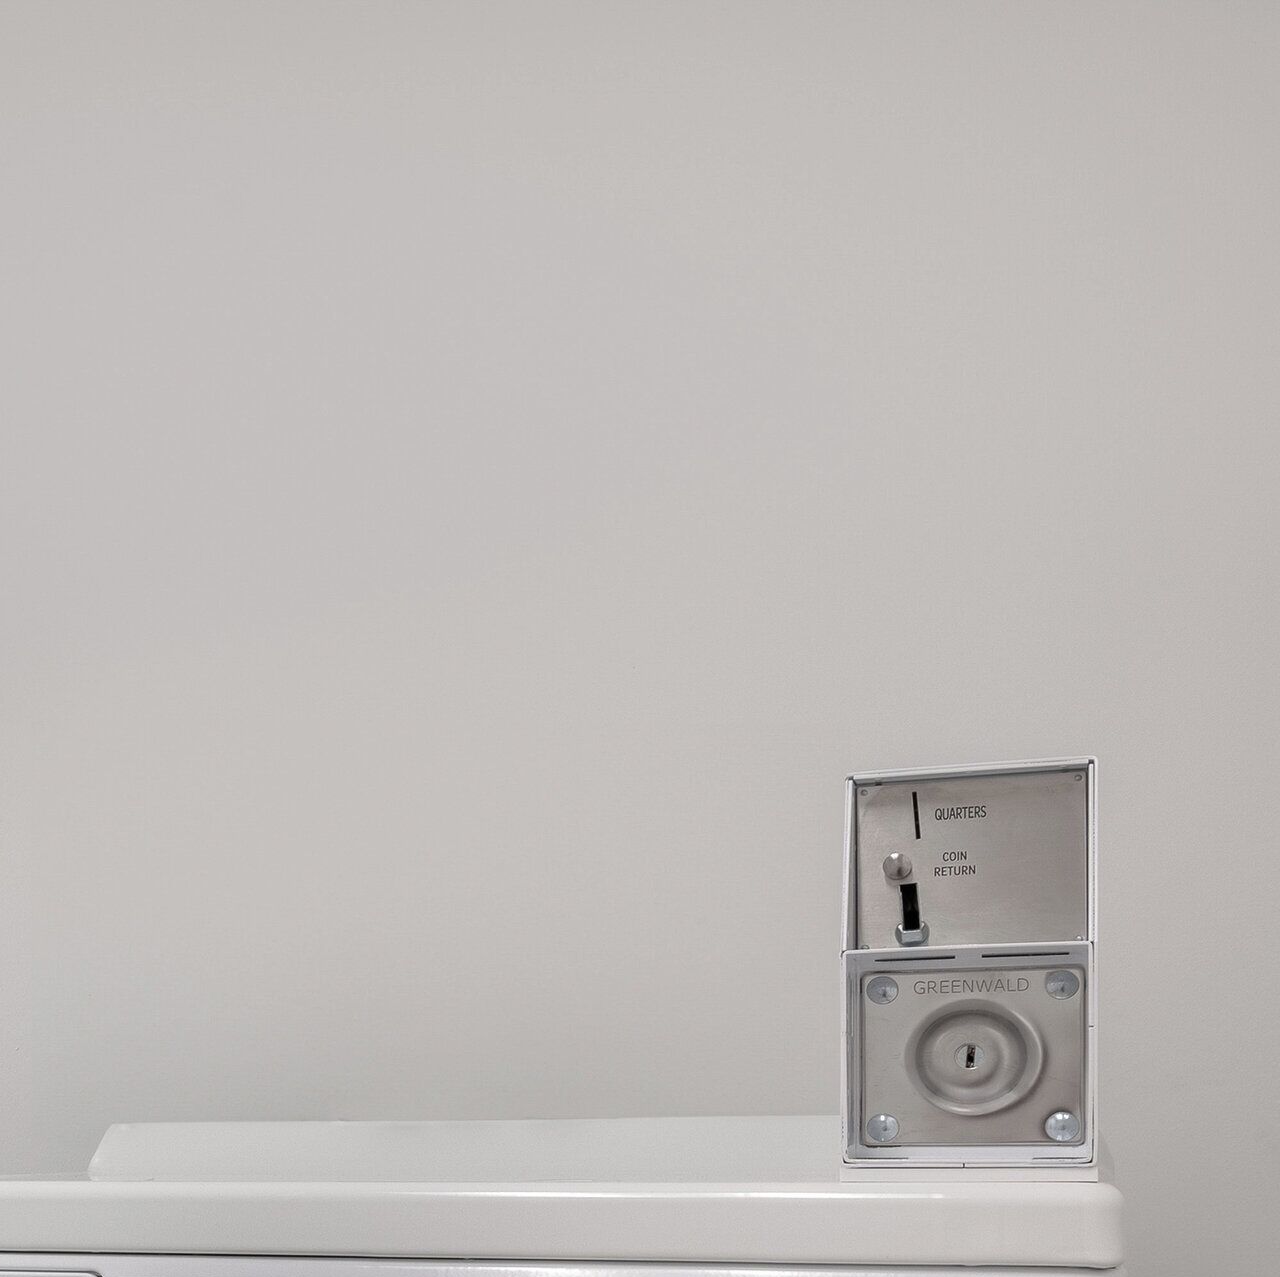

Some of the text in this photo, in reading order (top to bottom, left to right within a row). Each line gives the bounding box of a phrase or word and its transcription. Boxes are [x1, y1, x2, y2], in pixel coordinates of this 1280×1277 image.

[934, 805, 987, 821] QUARTERS
[942, 851, 967, 862] COIN
[934, 865, 976, 877] RETURN
[913, 977, 1030, 995] GREENWALD
